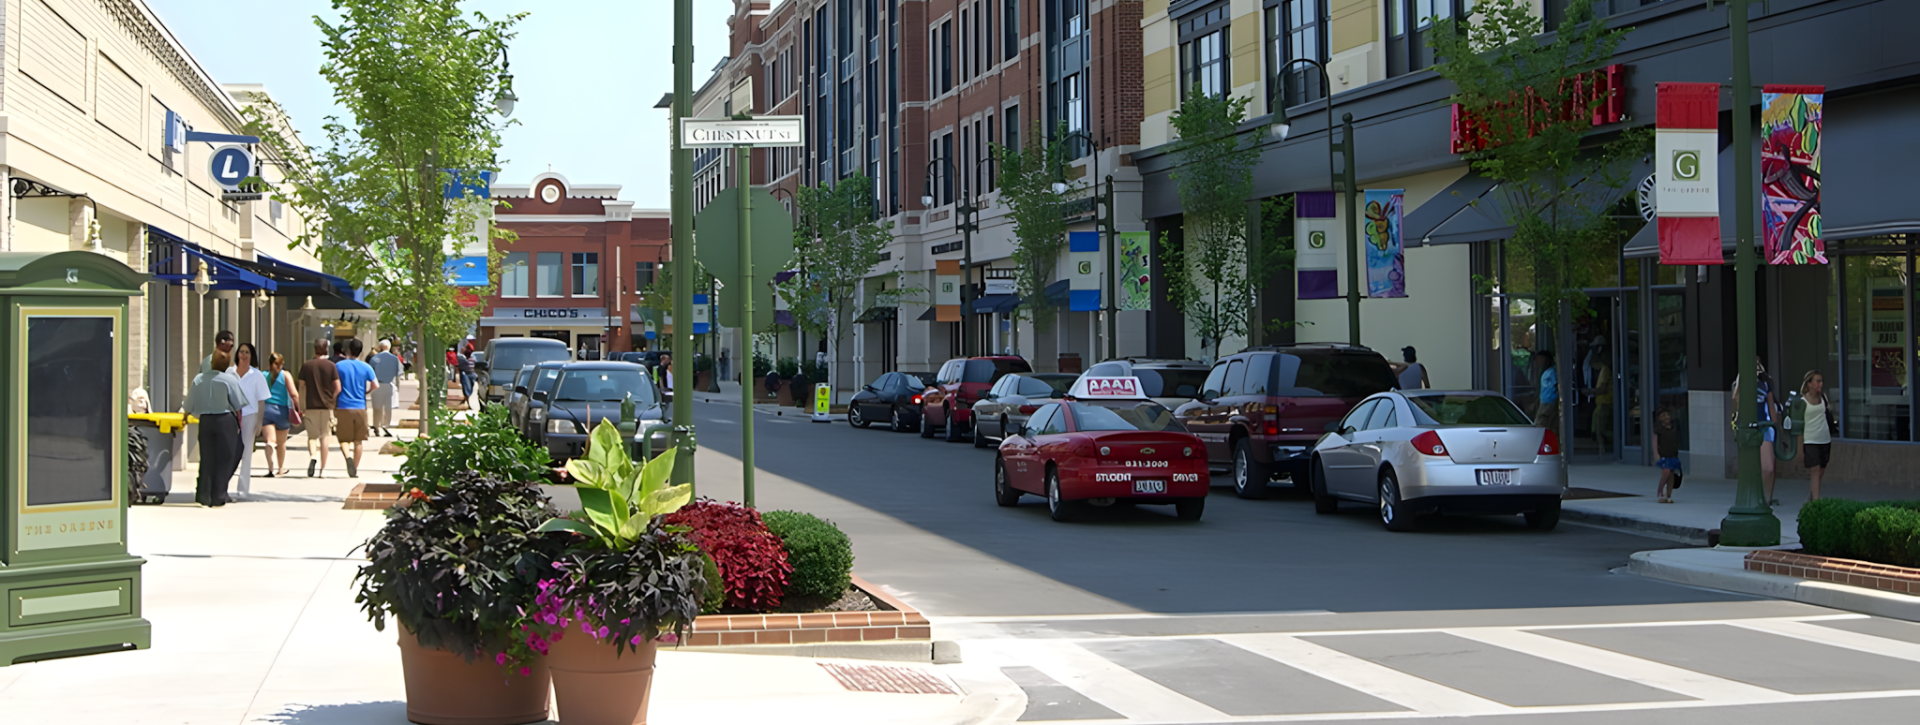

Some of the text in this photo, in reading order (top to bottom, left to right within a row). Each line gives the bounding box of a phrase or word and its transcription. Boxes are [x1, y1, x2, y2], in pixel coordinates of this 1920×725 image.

[692, 128, 777, 141] CHESTNUT
[221, 155, 239, 178] L
[1676, 153, 1696, 178] G
[524, 307, 578, 318] CHICO'S
[24, 525, 52, 536] THE
